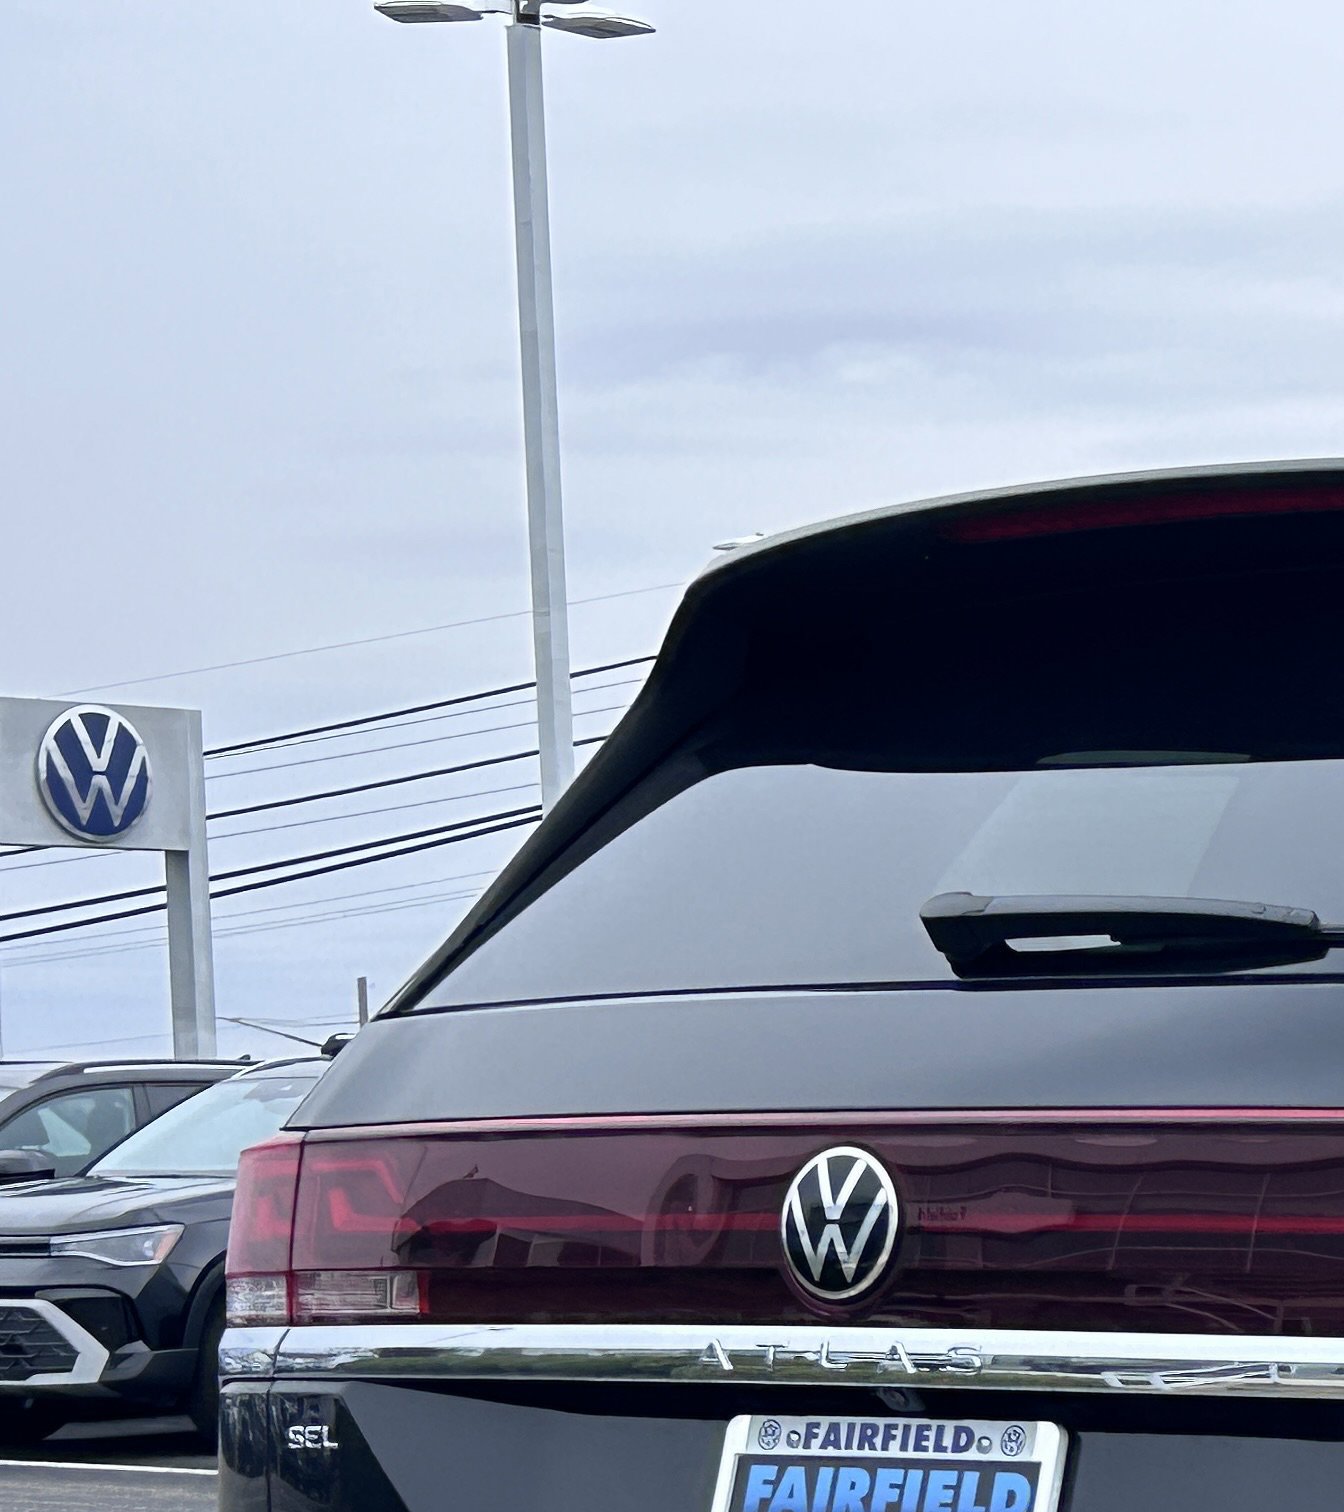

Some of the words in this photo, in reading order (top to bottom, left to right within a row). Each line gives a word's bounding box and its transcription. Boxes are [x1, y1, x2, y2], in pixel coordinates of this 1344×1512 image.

[39, 704, 152, 842] VW
[781, 1146, 898, 1300] VW
[701, 1336, 984, 1376] ATLAS
[288, 1425, 339, 1449] SEL
[801, 1421, 976, 1454] FAIRFIELD
